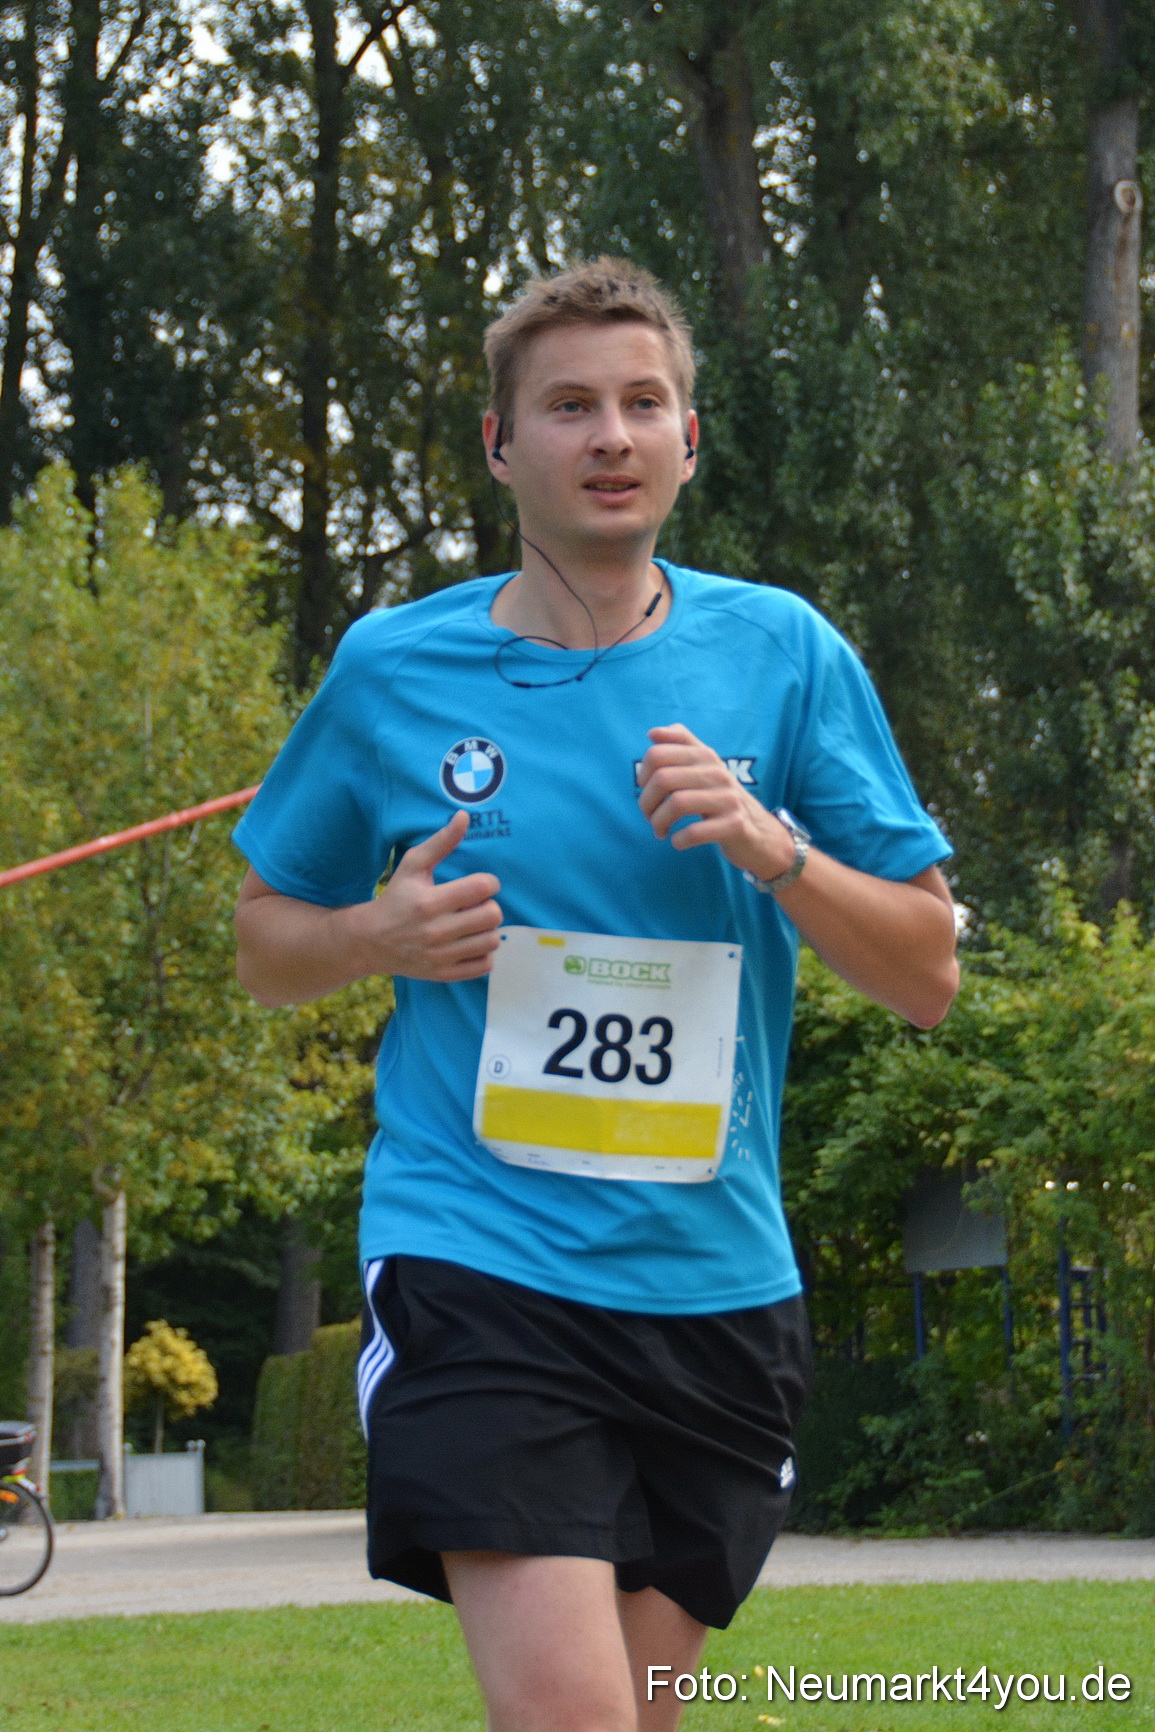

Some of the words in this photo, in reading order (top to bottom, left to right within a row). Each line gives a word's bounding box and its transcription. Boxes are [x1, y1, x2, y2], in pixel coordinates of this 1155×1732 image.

[445, 740, 499, 766] BMW
[449, 808, 511, 829] RTL
[588, 957, 671, 983] BOCK
[542, 1008, 673, 1085] 283
[493, 1060, 504, 1074] D
